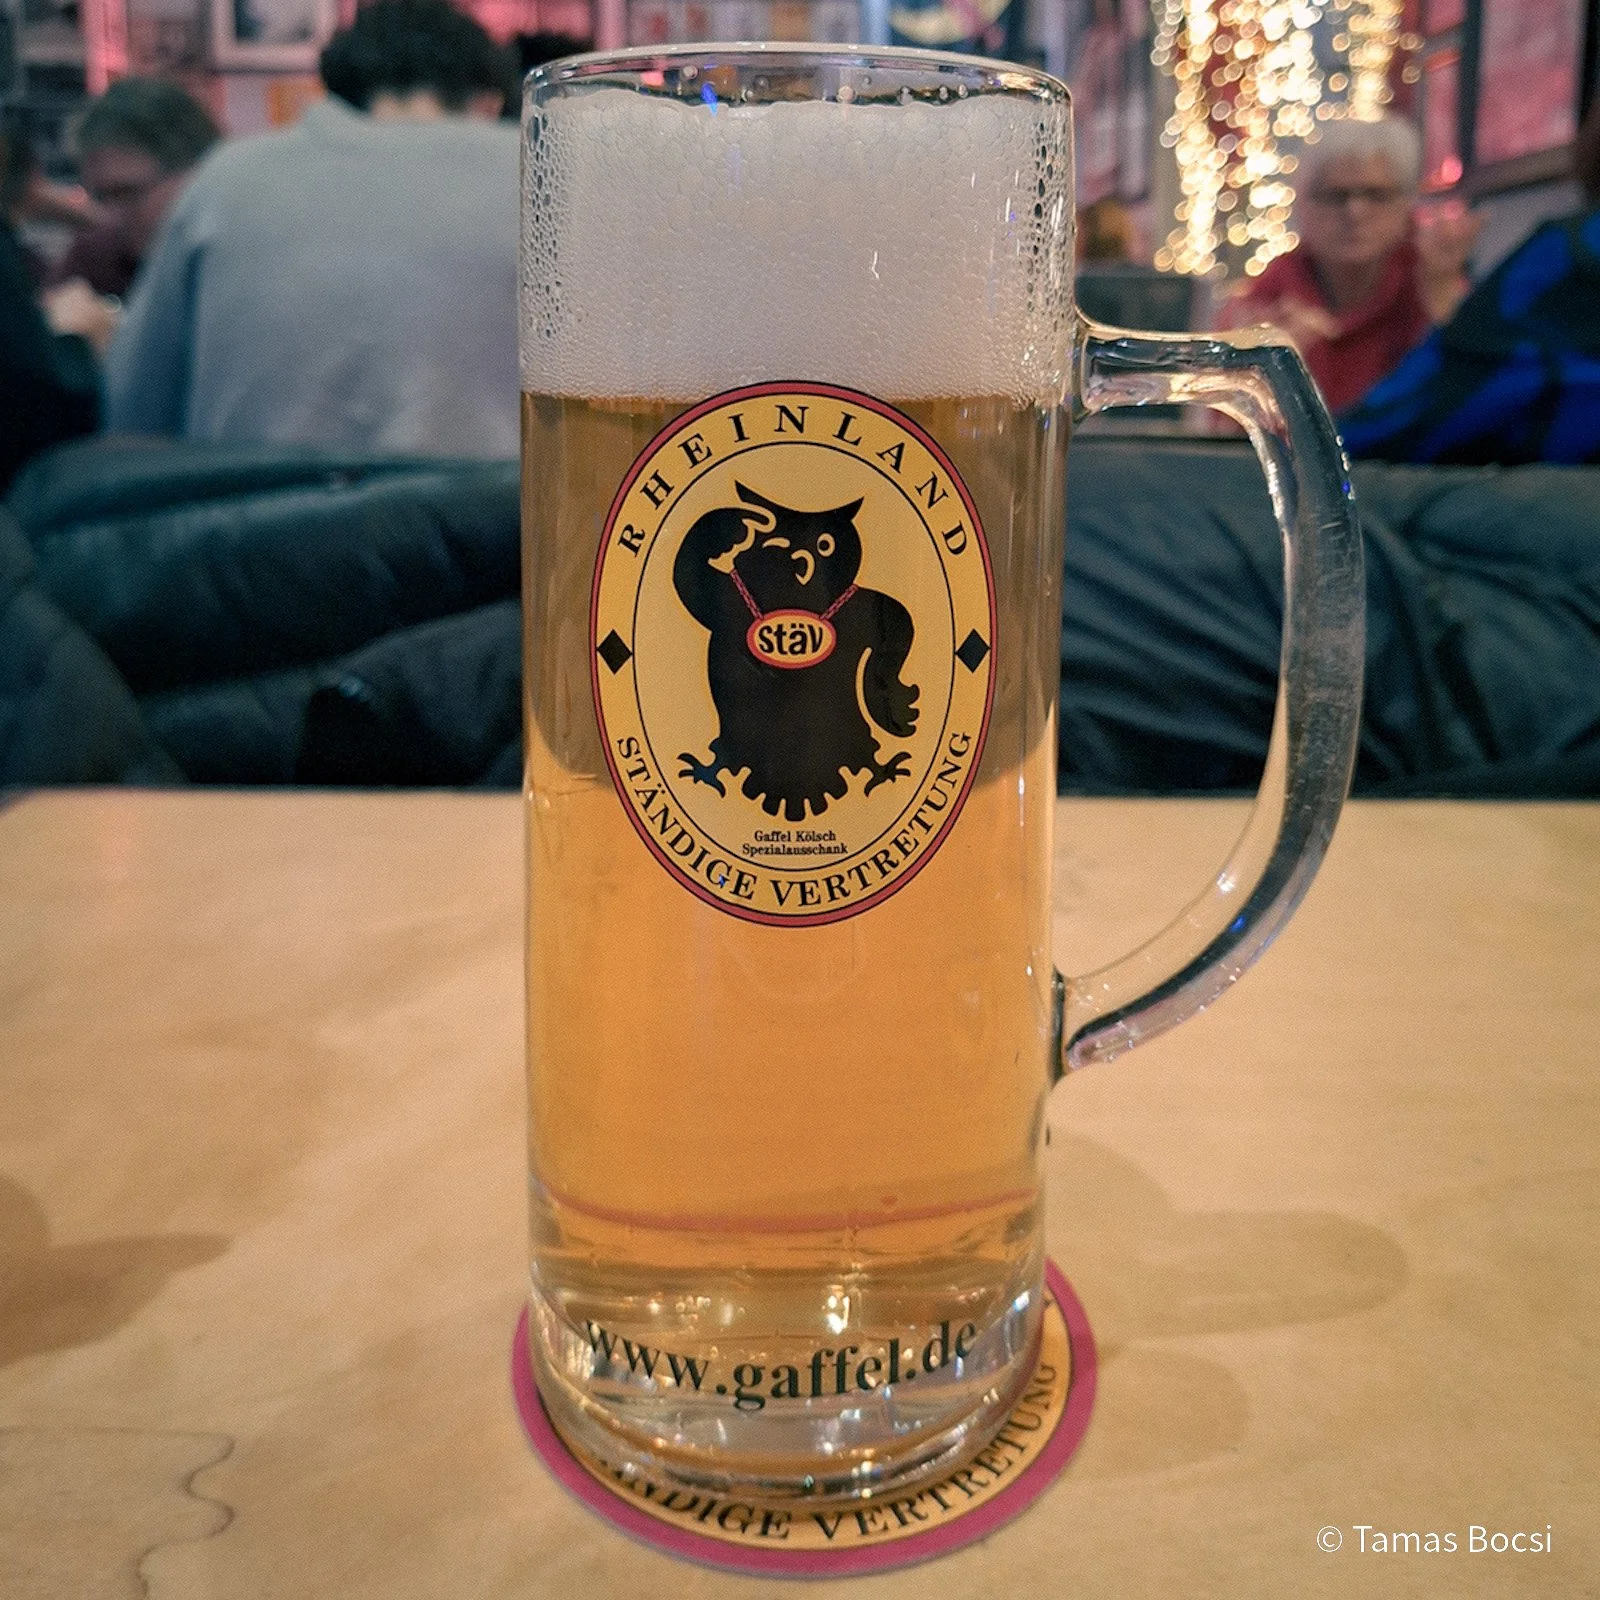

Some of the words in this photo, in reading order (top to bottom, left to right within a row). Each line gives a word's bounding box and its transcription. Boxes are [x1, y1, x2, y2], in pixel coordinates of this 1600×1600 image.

[617, 404, 968, 557] RHEINLAND
[758, 623, 823, 655] stäv
[617, 736, 757, 900] STÄNDIGE
[769, 731, 972, 907] VERTRETUNG
[742, 842, 848, 857] Spezialausschank
[754, 830, 791, 842] Gaffel
[796, 830, 837, 842] Kölsch
[583, 1318, 977, 1410] www.gaffel.de
[807, 1363, 1057, 1541] VERTRETUNG
